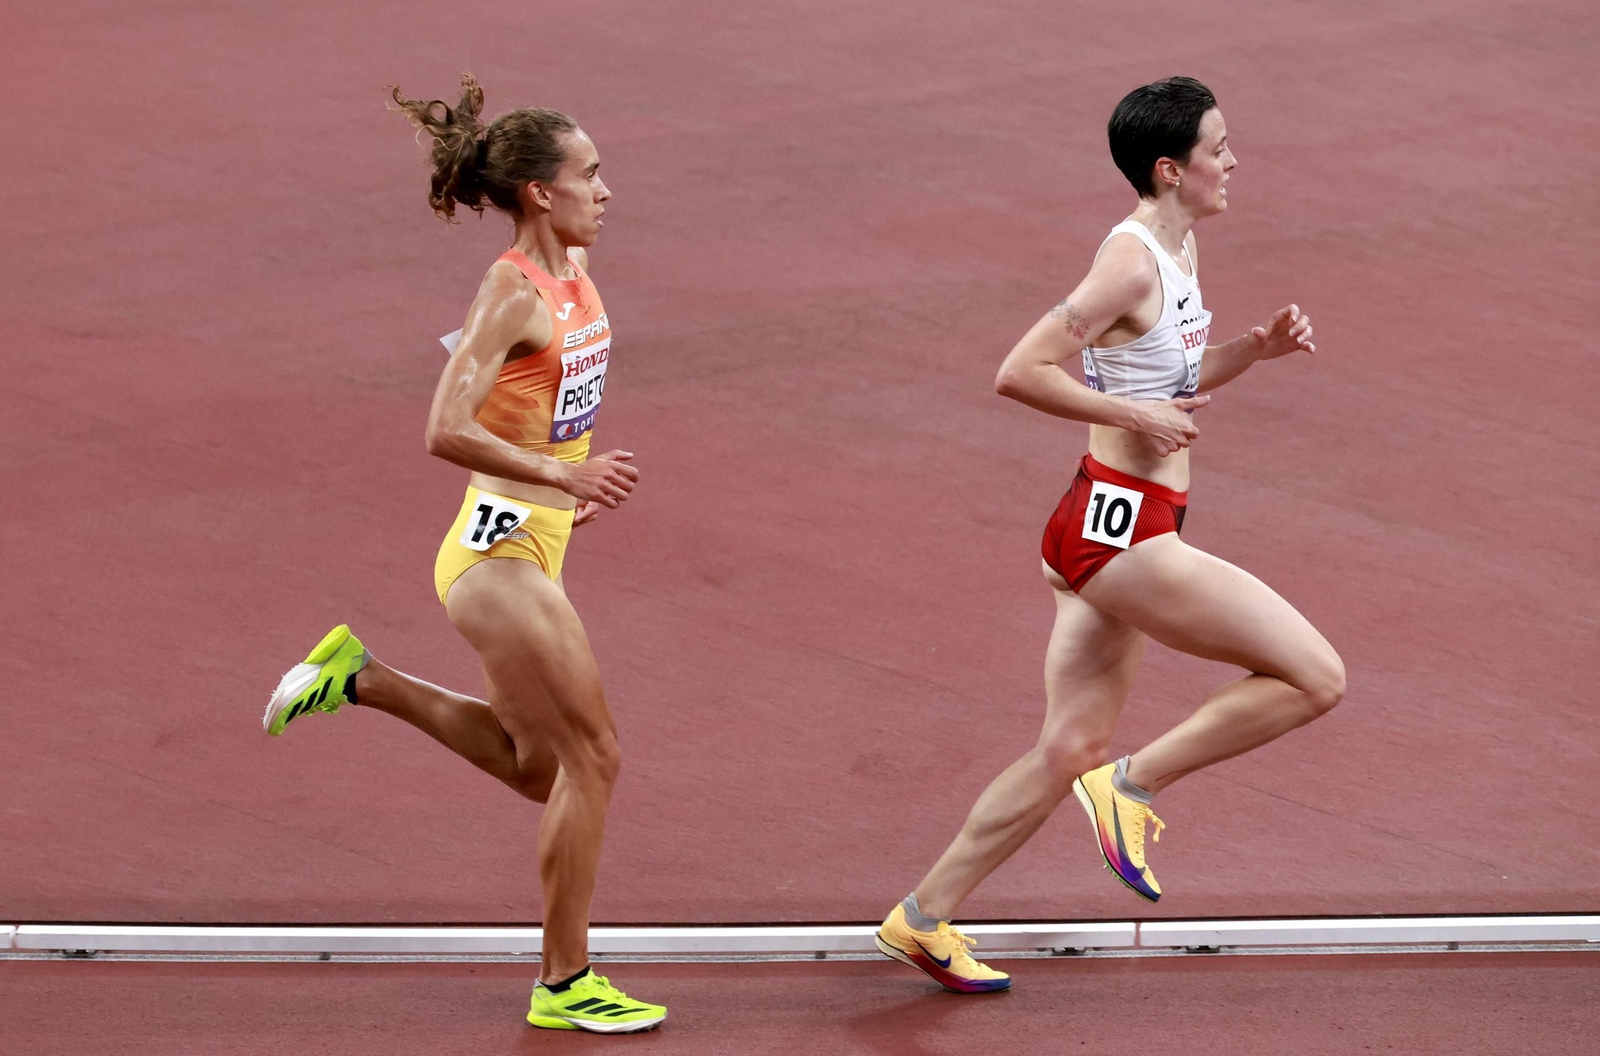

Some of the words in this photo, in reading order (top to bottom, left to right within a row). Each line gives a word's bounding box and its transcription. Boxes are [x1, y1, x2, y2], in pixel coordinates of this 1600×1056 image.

[564, 347, 609, 379] HOND
[574, 413, 596, 433] TOKY
[471, 503, 520, 546] 18
[1091, 493, 1133, 538] 10
